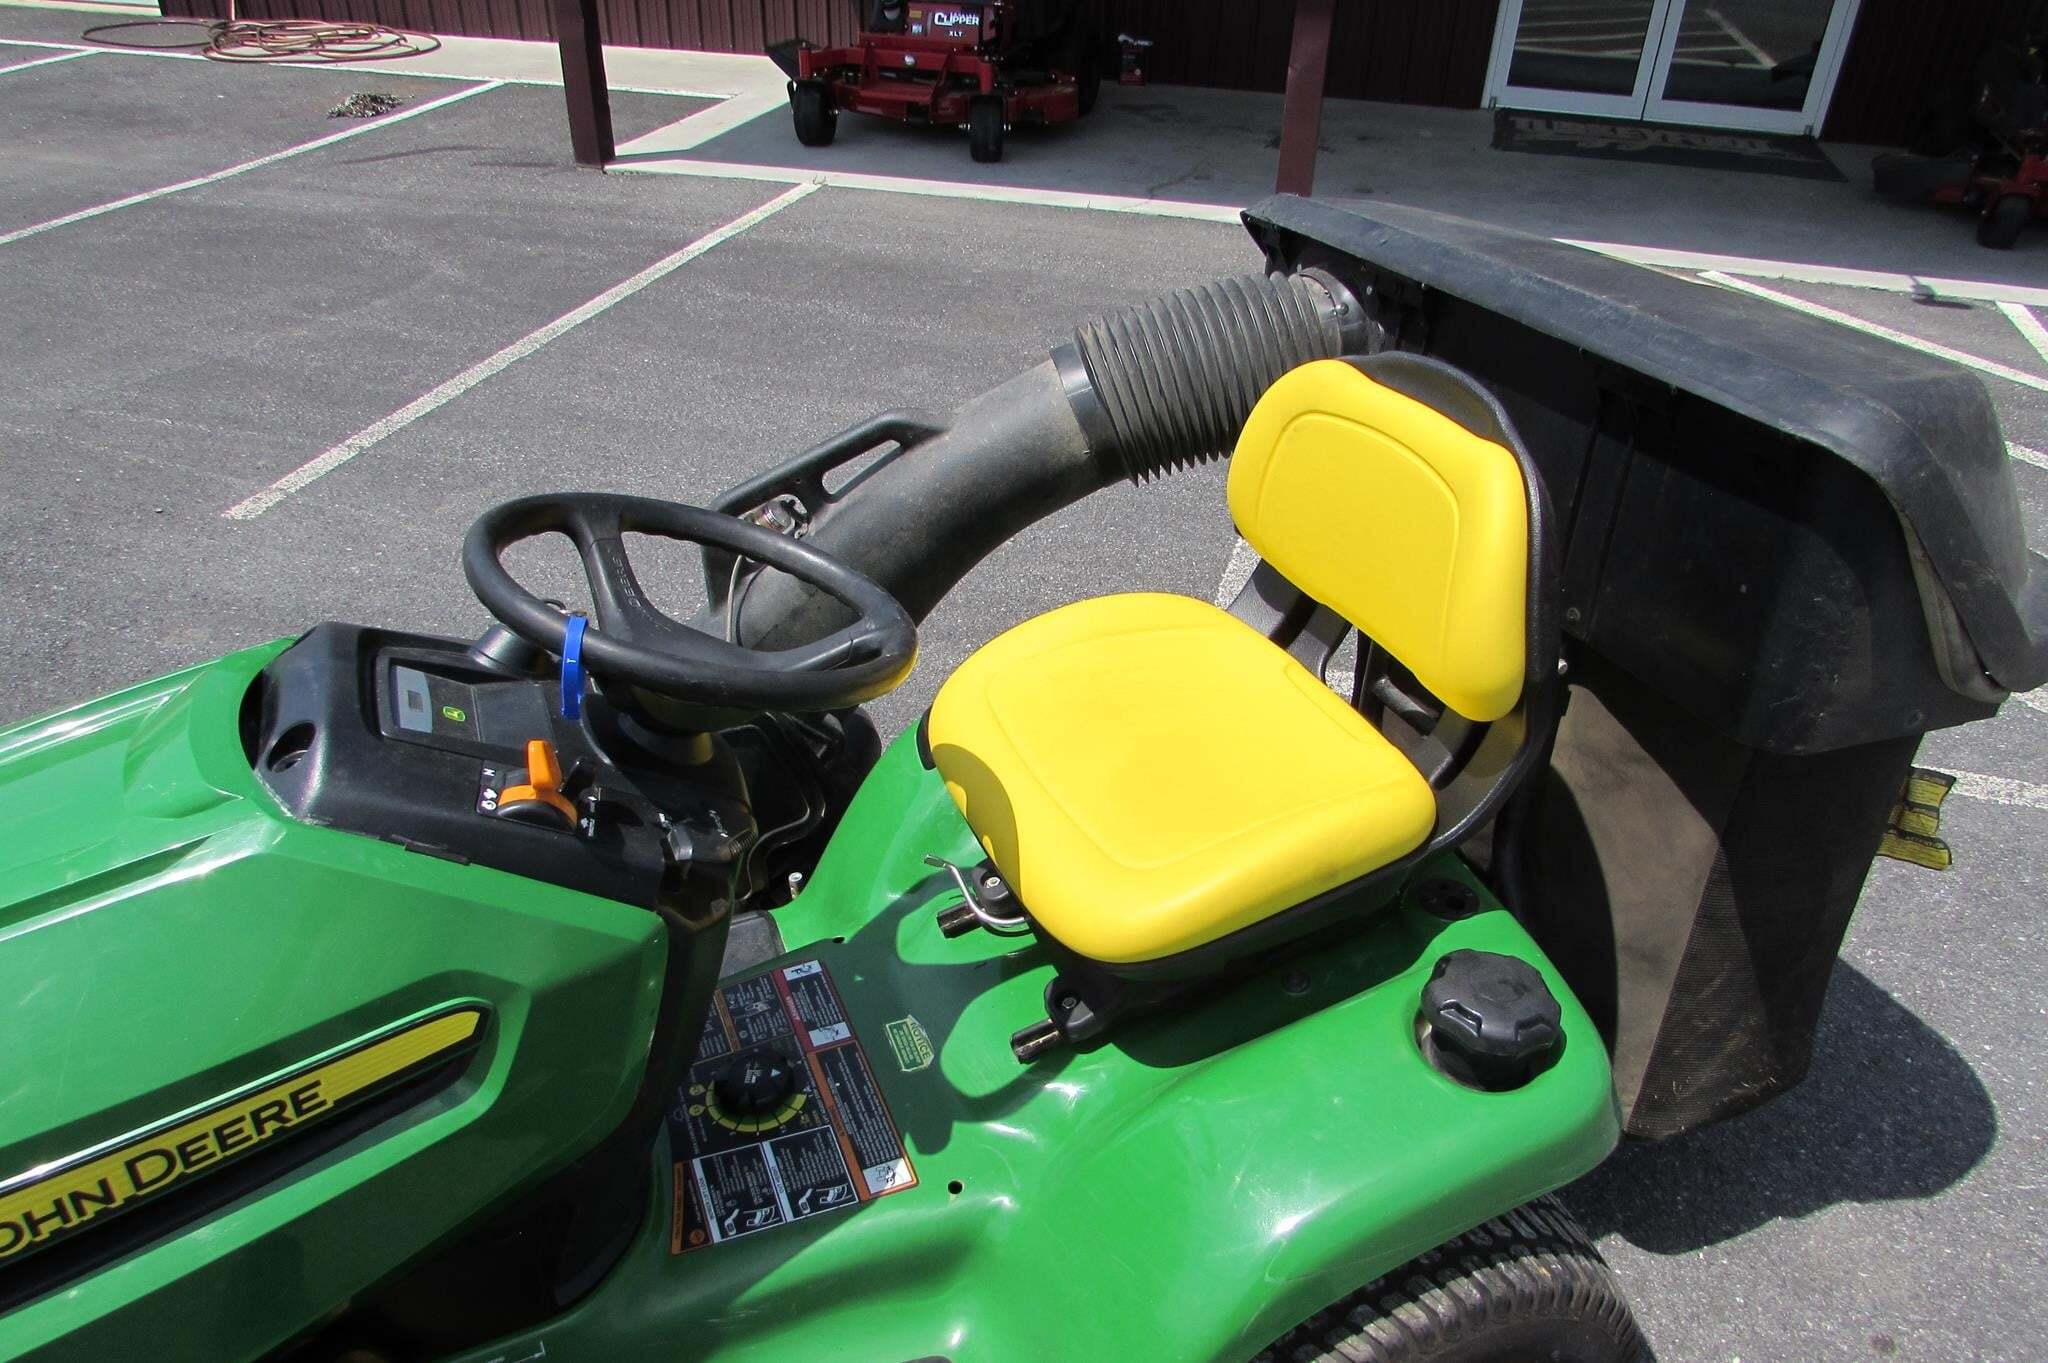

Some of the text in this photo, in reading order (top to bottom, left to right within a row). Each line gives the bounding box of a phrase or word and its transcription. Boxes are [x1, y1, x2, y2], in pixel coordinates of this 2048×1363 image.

[934, 12, 980, 26] CLIPPER
[910, 1022, 931, 1060] NOTICE
[124, 1079, 327, 1192] DEERE
